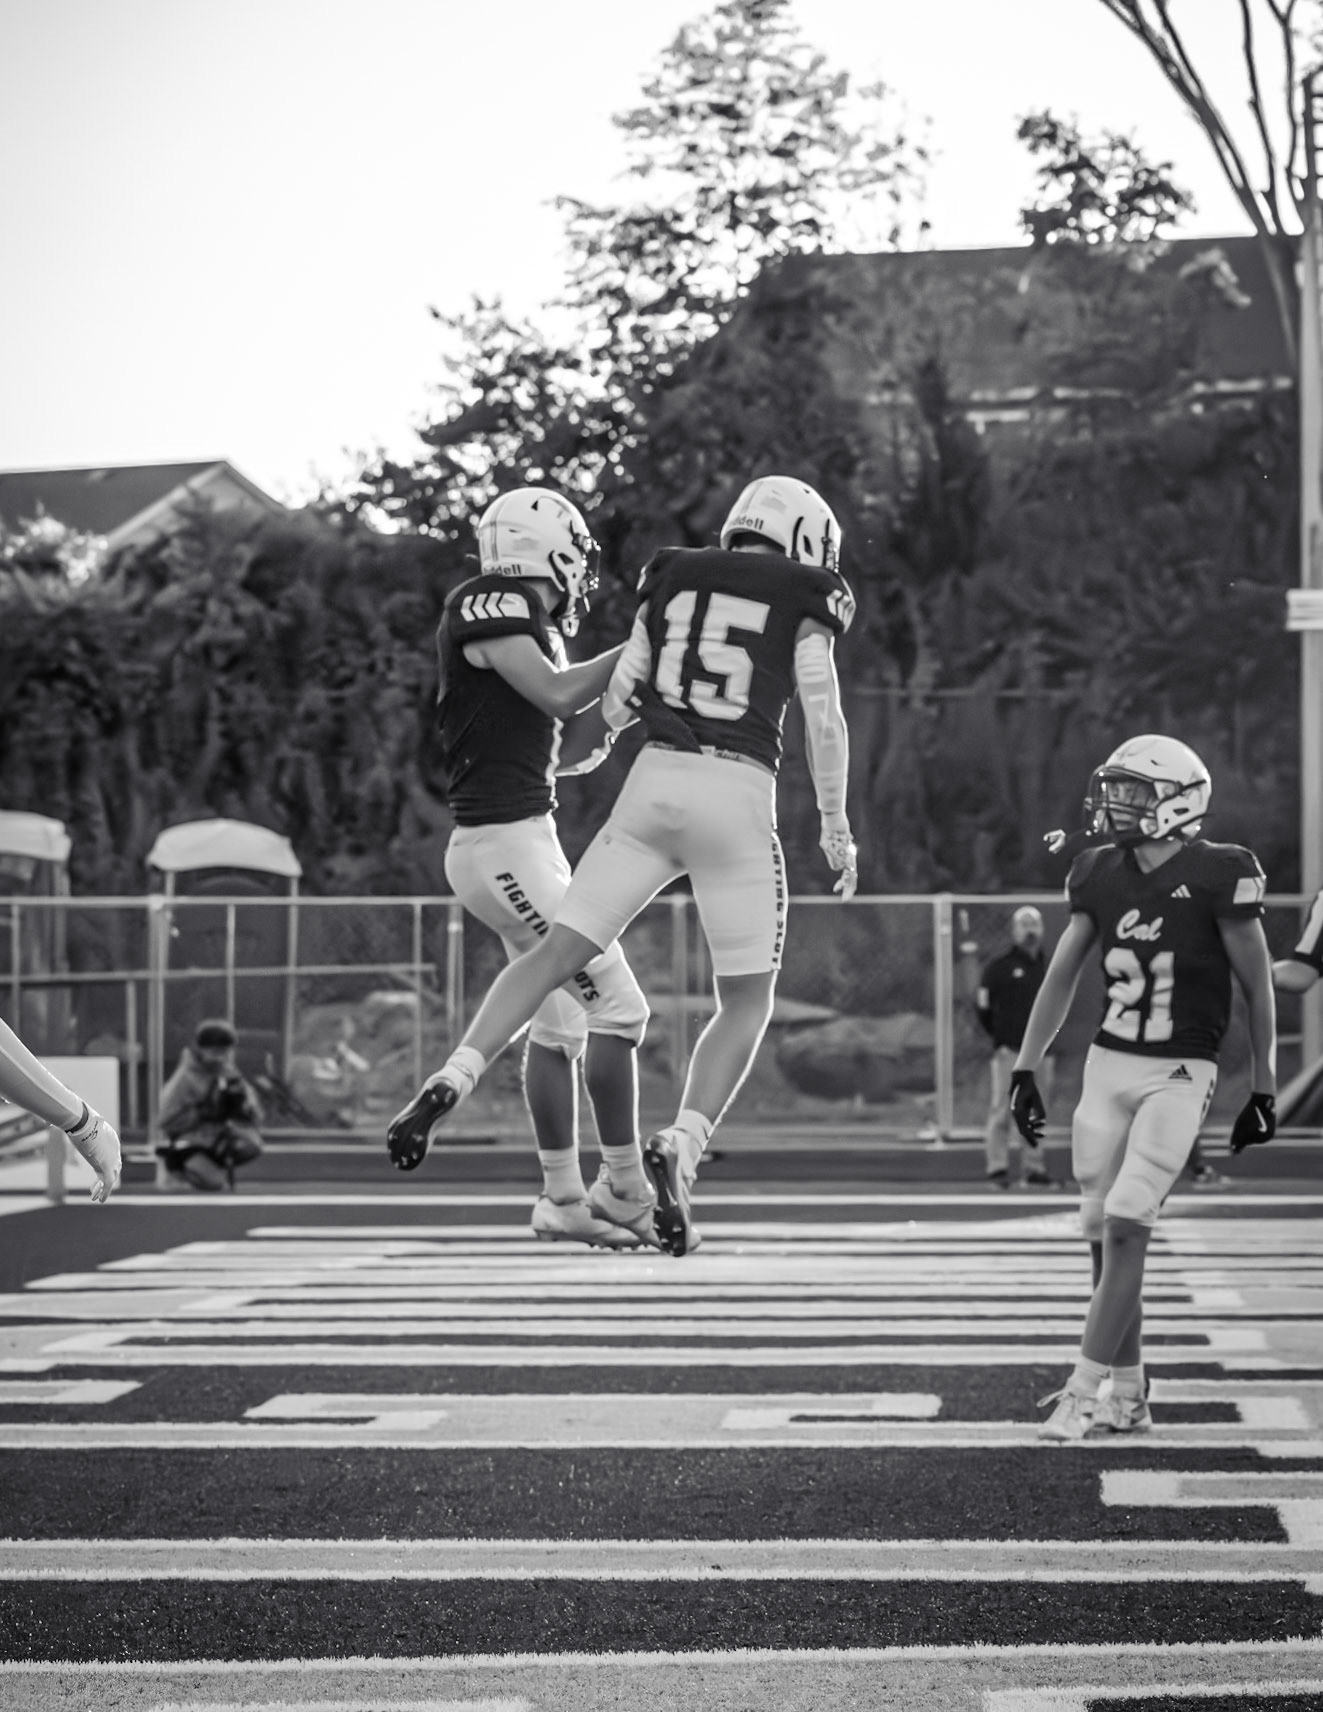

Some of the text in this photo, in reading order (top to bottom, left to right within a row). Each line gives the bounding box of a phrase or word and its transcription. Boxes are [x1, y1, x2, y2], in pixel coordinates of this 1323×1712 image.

[655, 590, 771, 721] 15
[1116, 908, 1164, 942] Cal
[574, 970, 600, 1002] OTS
[1101, 947, 1175, 1042] 21
